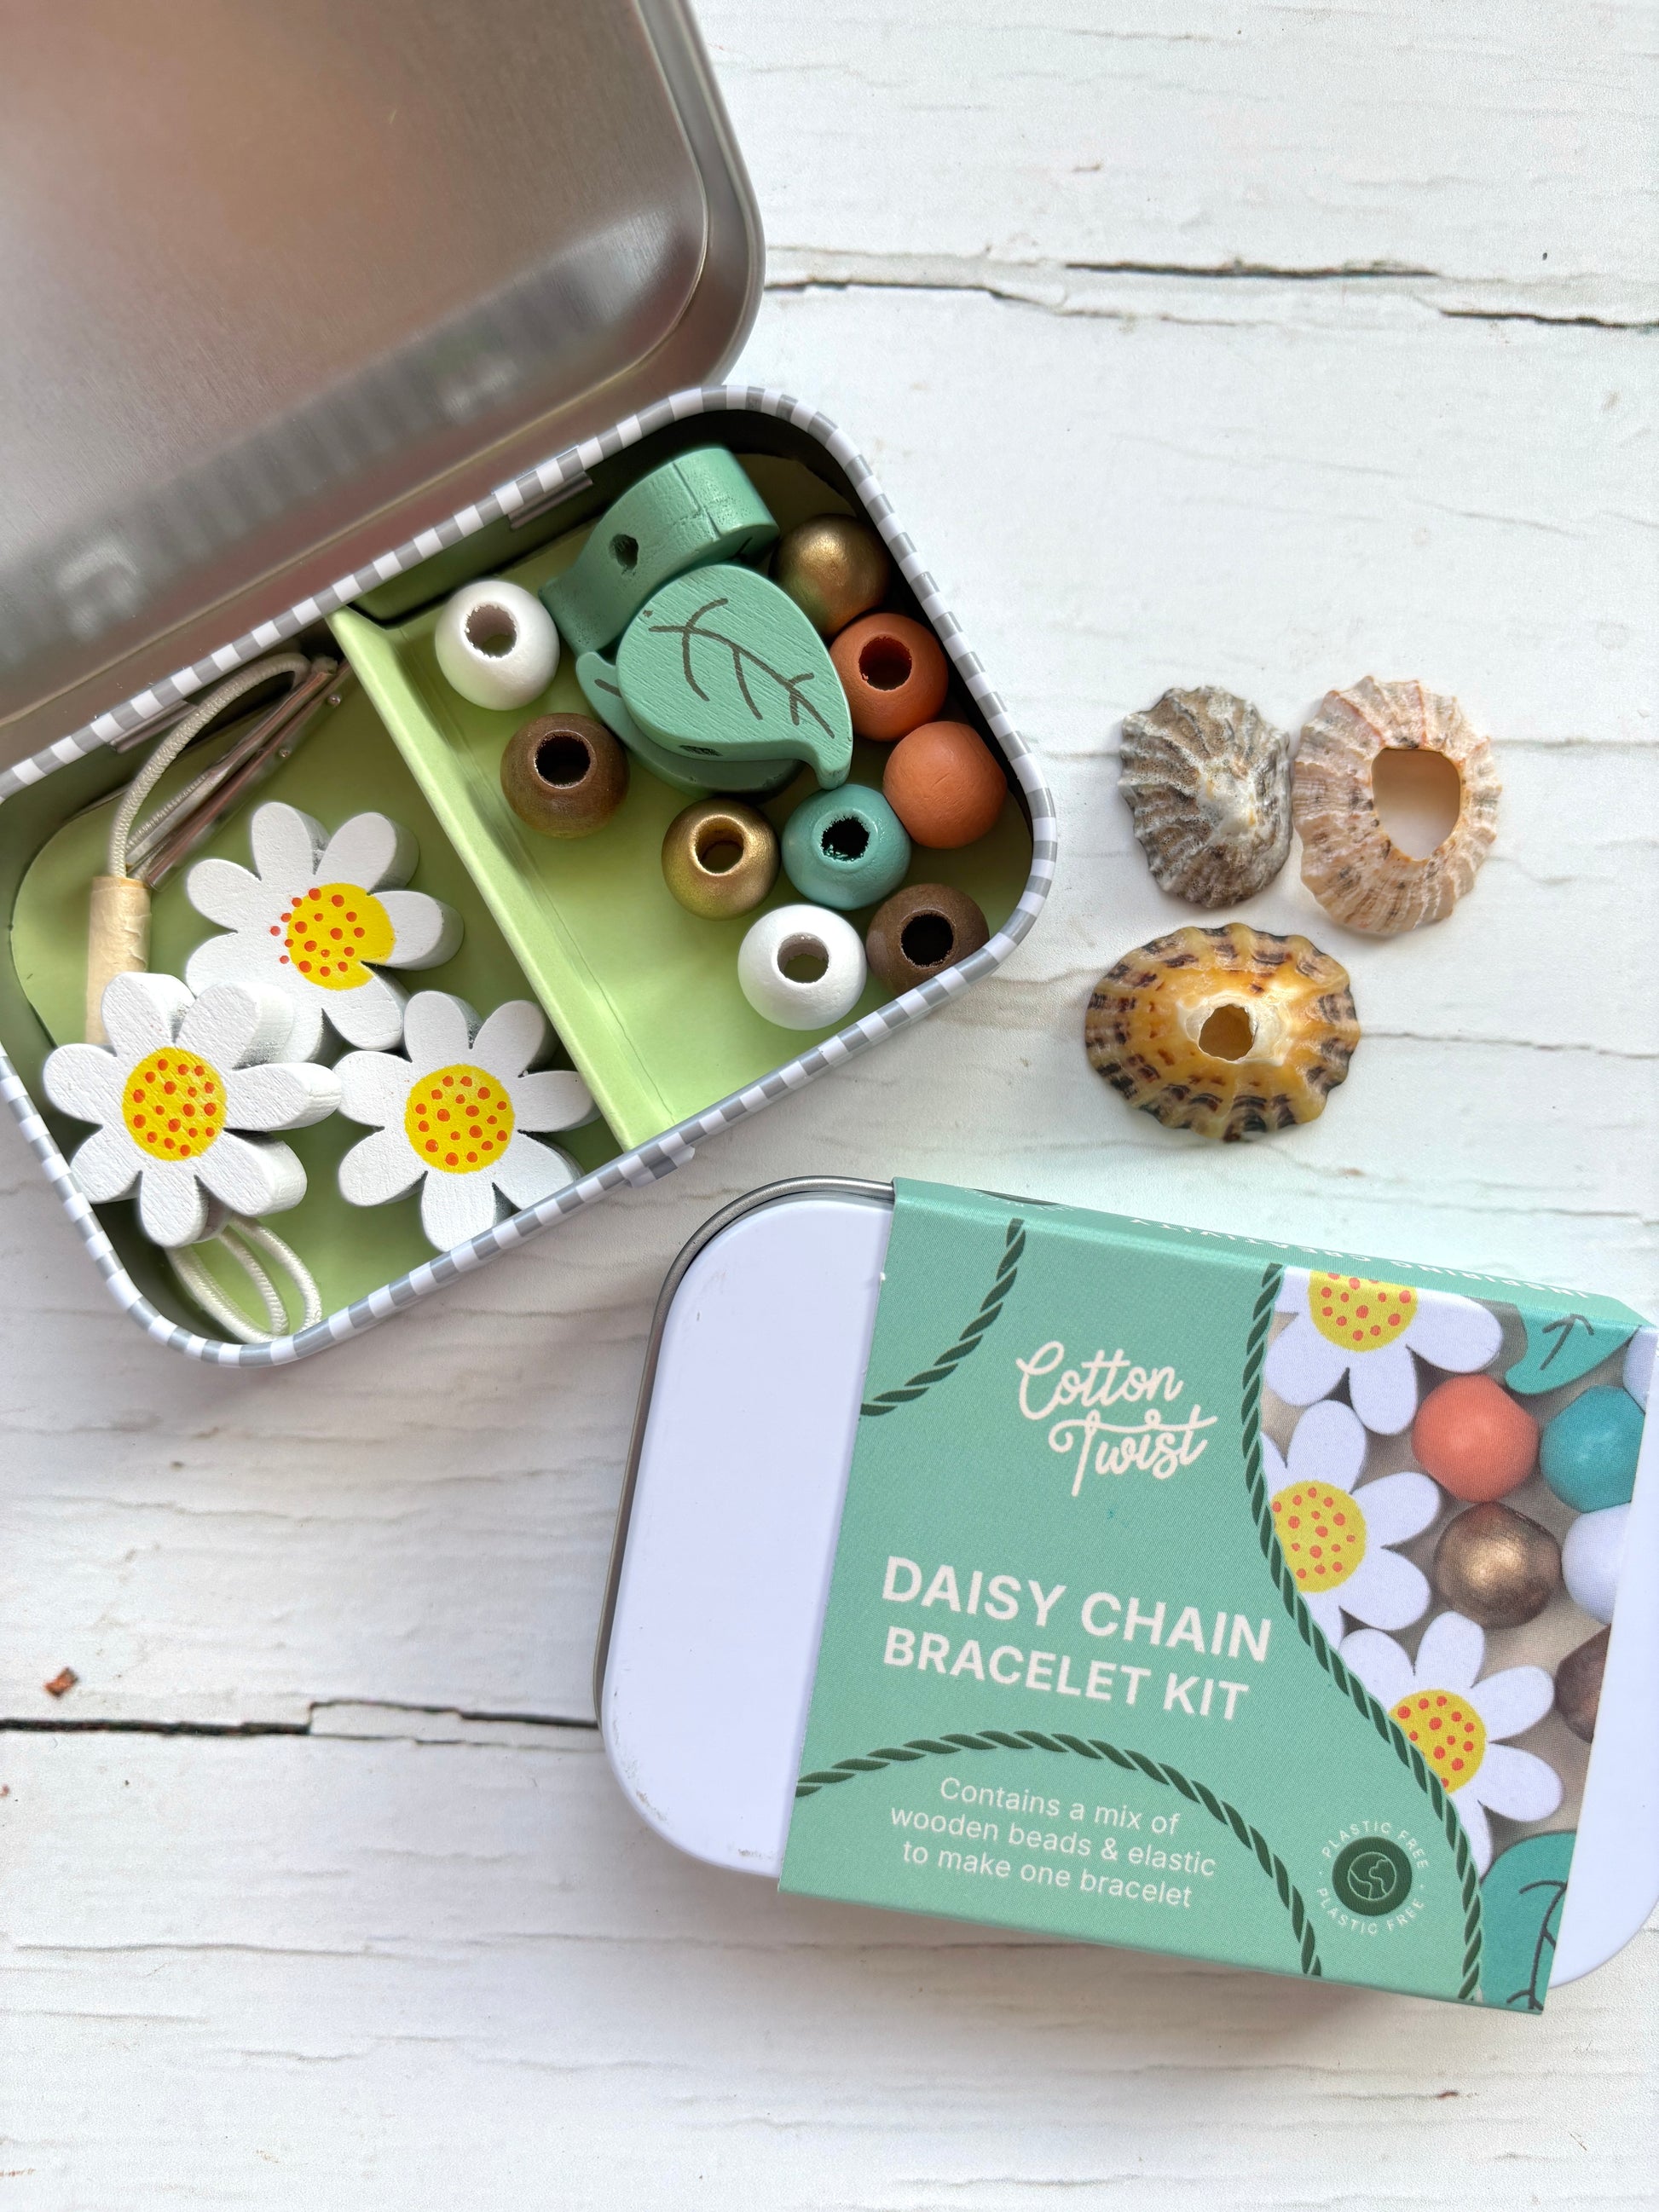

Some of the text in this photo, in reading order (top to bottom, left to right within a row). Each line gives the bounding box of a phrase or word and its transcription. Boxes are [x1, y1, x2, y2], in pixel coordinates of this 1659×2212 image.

[1129, 1218, 1589, 1300] INSPIRING CREATIVITY
[1015, 1340, 1185, 1421] Cotton
[1048, 1403, 1219, 1497] Twist
[882, 1556, 1272, 1662] DAISY CHAIN
[883, 1626, 1250, 1720] BRACELET KIT
[890, 1808, 1217, 1878] wooden beads & elastic
[939, 1776, 1181, 1835] Contains a mix of
[903, 1841, 1193, 1909] to make one bracelet
[1322, 1821, 1430, 1869] PLASTIC FREE
[1316, 1886, 1425, 1937] PLASTIC FREE
